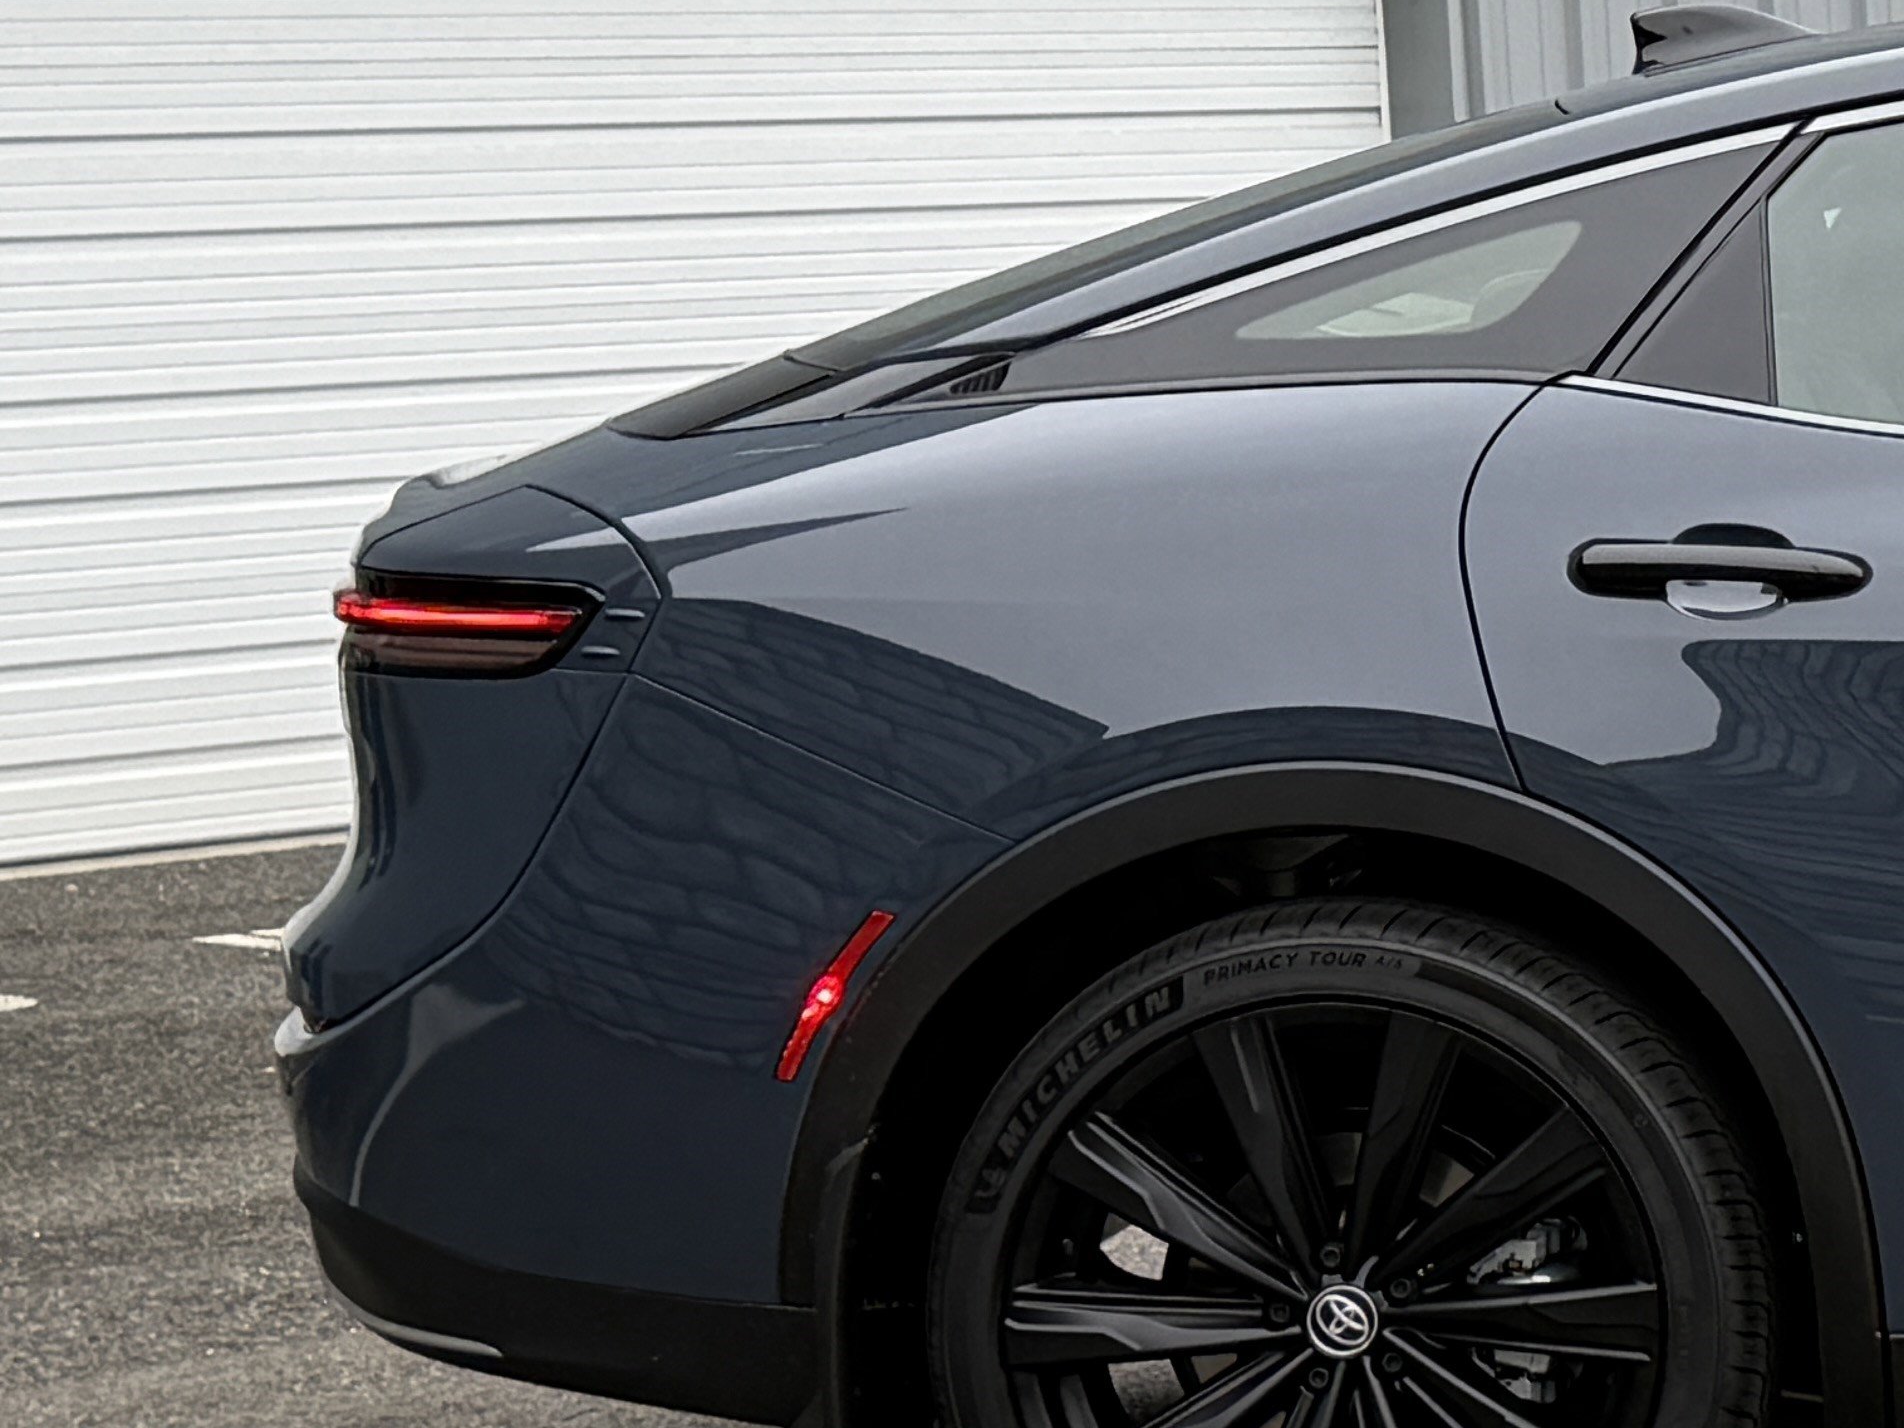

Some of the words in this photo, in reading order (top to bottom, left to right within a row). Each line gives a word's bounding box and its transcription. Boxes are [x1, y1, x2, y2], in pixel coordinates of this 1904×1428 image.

[1202, 951, 1300, 987] PRIMACY
[1308, 950, 1369, 969] TOUR
[997, 985, 1171, 1161] MICHELIN
